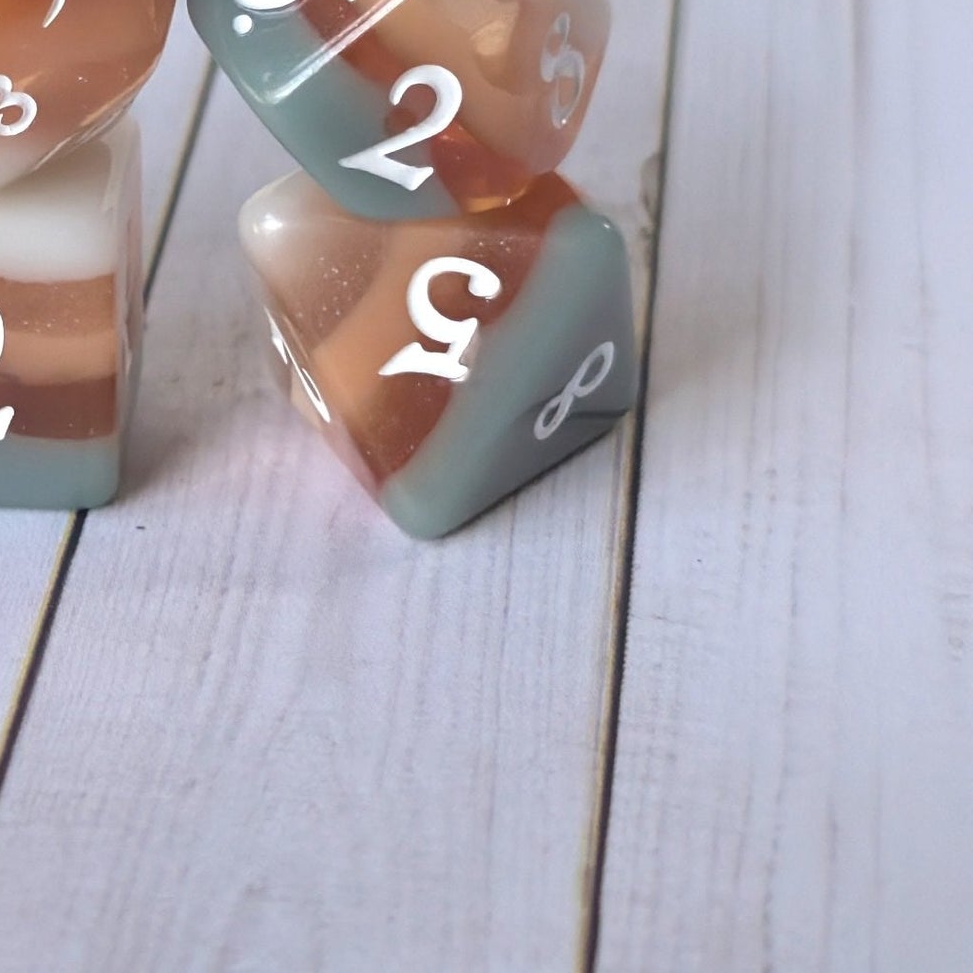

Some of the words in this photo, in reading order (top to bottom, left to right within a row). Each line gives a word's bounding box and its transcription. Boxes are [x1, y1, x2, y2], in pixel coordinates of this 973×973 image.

[338, 64, 463, 192] 2
[378, 256, 502, 382] 5
[533, 341, 615, 440] 8
